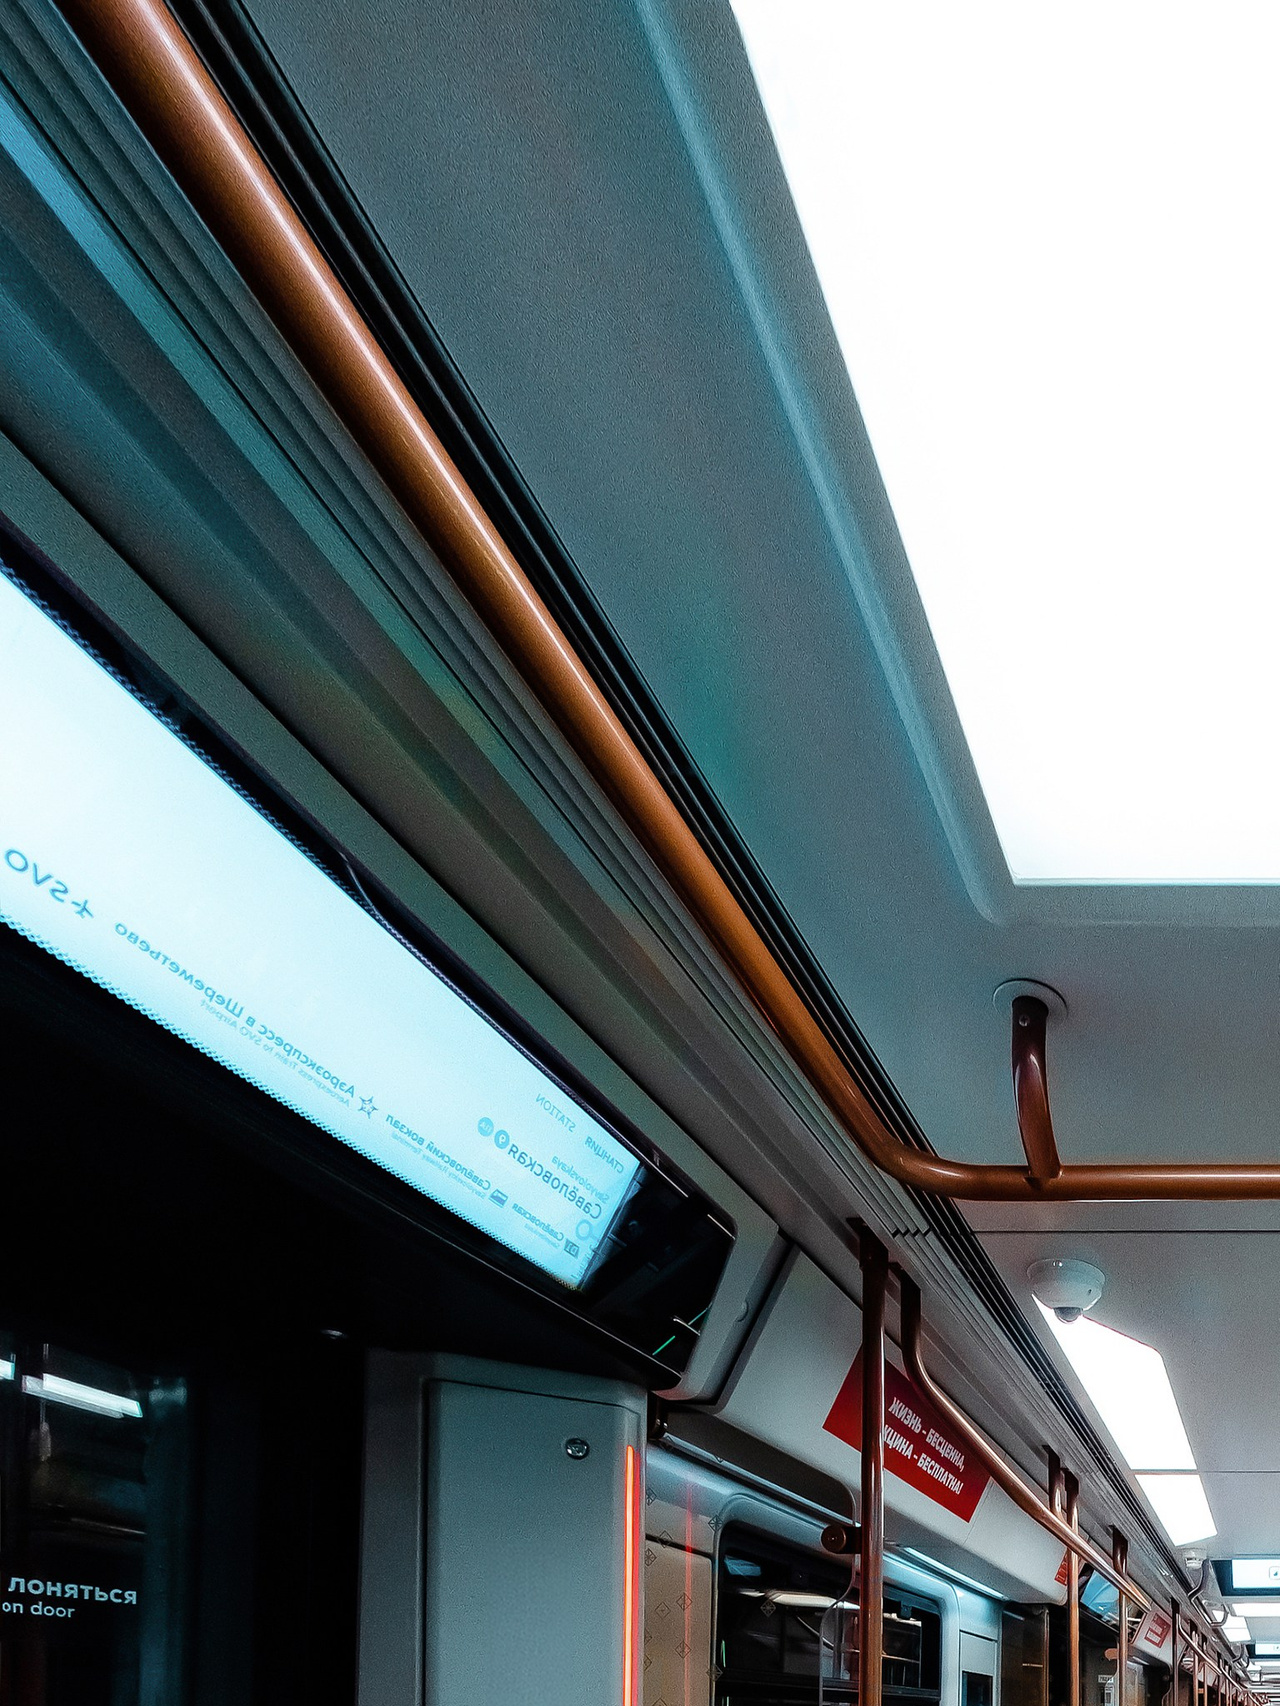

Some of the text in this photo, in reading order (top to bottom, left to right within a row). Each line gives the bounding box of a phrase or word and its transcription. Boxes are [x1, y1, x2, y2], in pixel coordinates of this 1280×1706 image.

[888, 1396, 922, 1434] ЖИЗНЬ
[925, 1428, 965, 1473] БЕСЦЕННА,
[917, 1452, 964, 1495] БЕСПЛАТНА!
[8, 1577, 137, 1605] лоняться
[2, 1601, 76, 1618] on door
